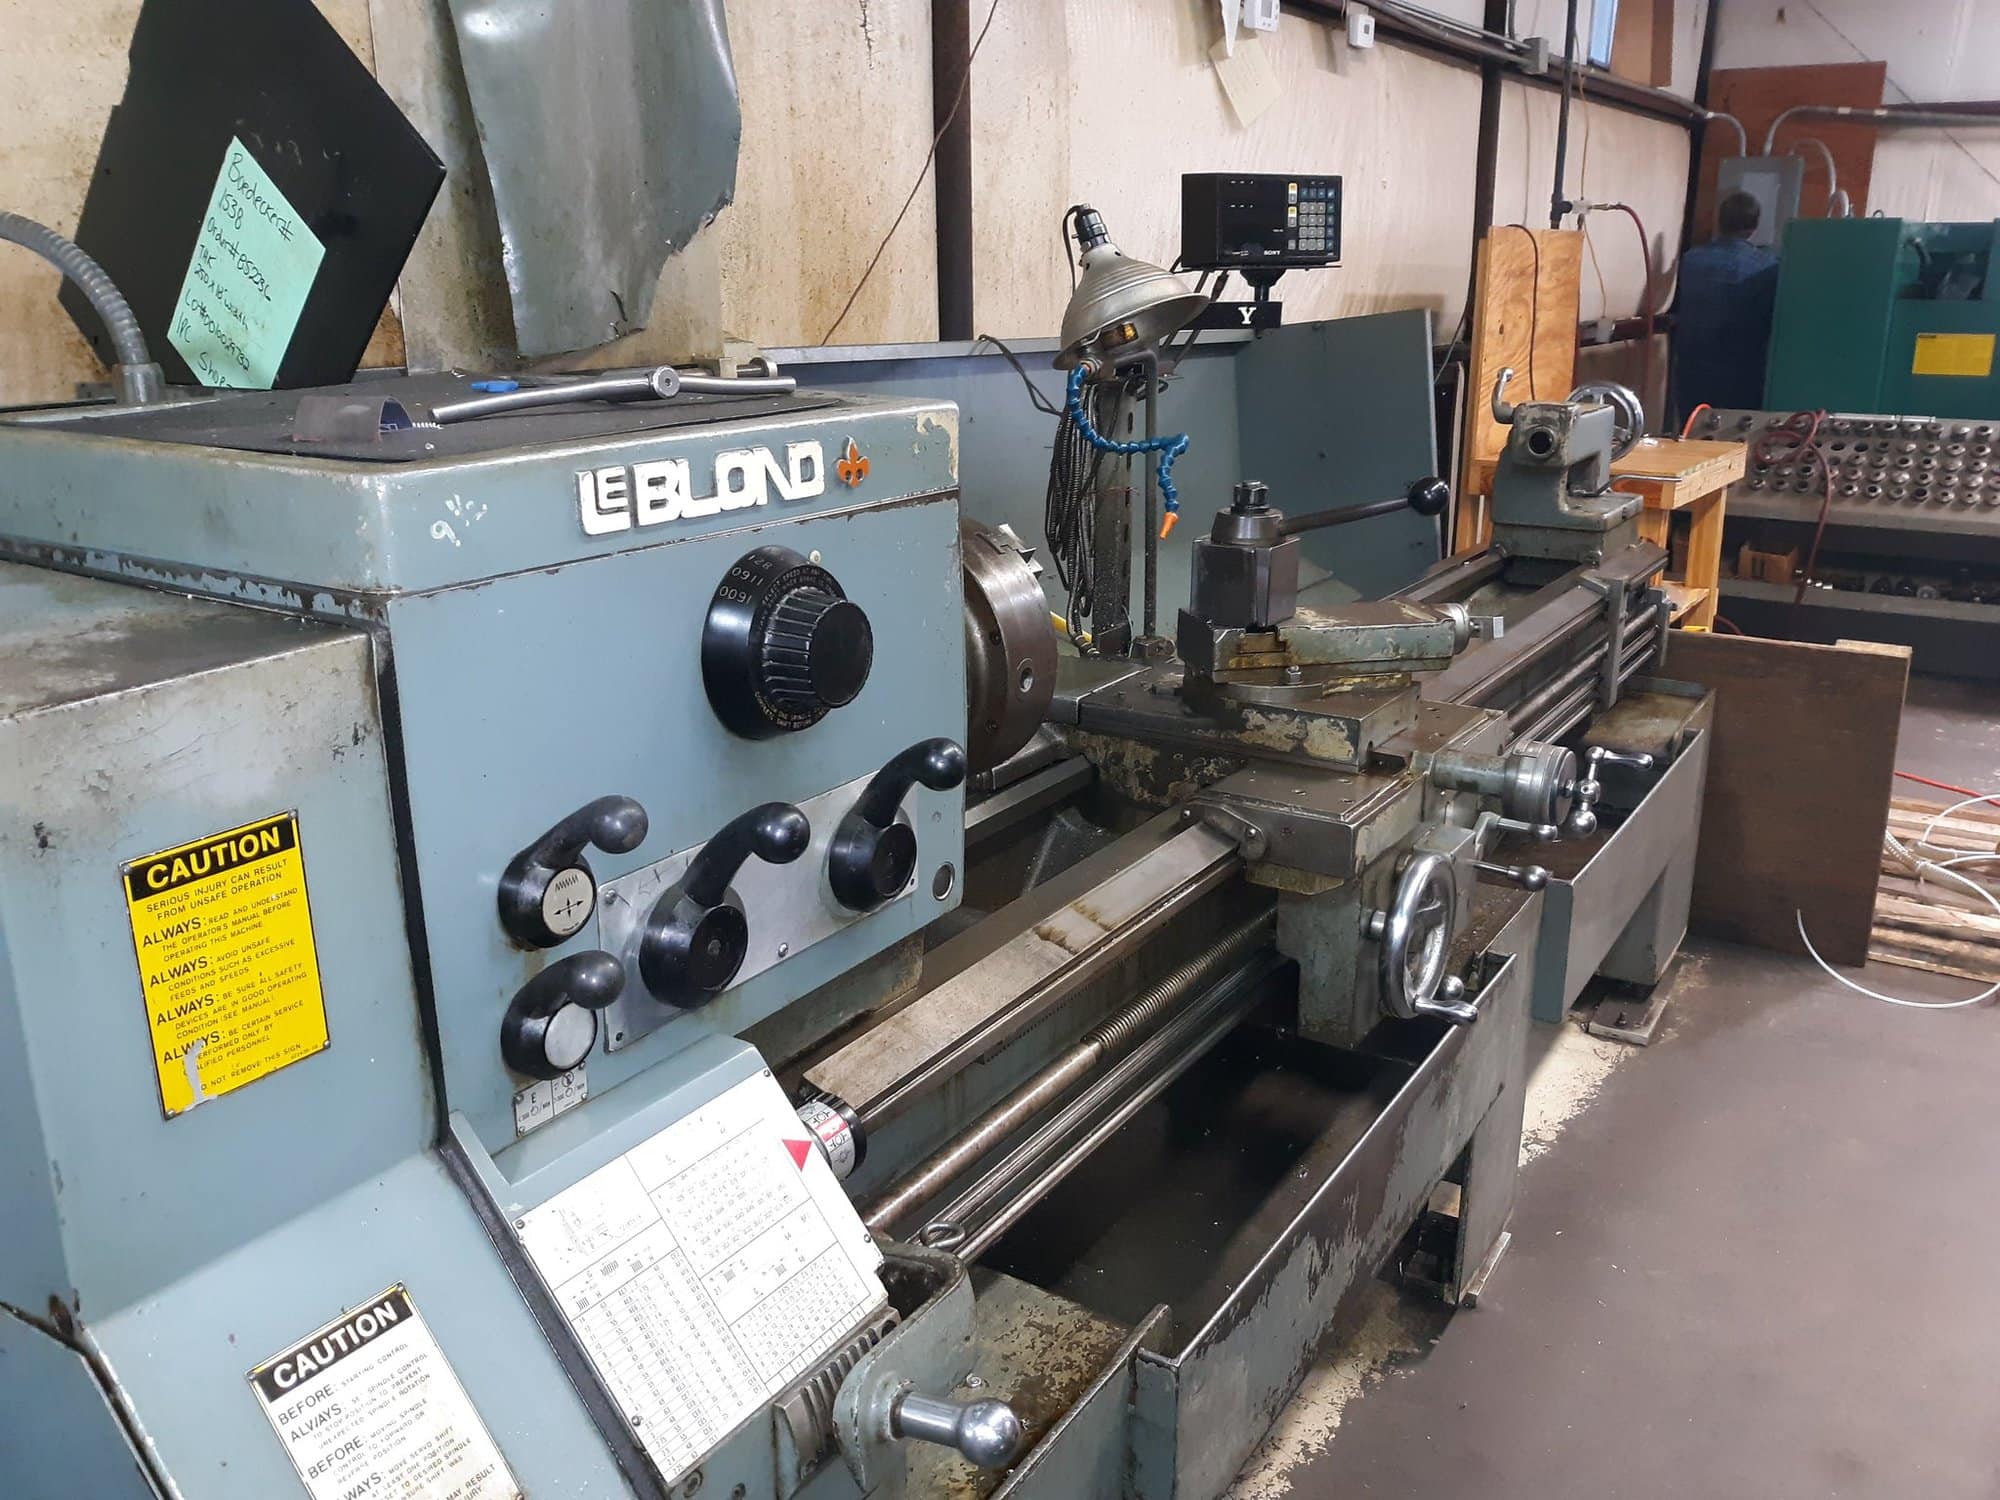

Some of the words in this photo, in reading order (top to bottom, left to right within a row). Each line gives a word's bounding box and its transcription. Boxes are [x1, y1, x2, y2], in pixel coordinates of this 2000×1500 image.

[218, 188, 244, 230] 1538
[1238, 306, 1257, 324] Y
[146, 826, 280, 891] CAUTION
[147, 892, 189, 913] SERIOUS
[195, 879, 226, 896] INJURY
[231, 871, 250, 884] CAN
[254, 859, 287, 876] RESULT
[158, 905, 185, 920] FROM
[190, 890, 227, 909] UNSAFE
[232, 872, 281, 894] OPERATION
[162, 941, 177, 952] THE
[232, 912, 259, 926] MANUAL
[263, 900, 291, 915] BEFORE
[209, 912, 228, 923] READ
[234, 905, 248, 914] AND
[164, 942, 207, 962] OPERATING
[211, 935, 227, 945] THIS
[231, 922, 262, 937] MACHINE
[217, 949, 238, 962] AVOID
[242, 937, 270, 952] UNSAFE
[169, 969, 216, 991] CONDITIONS
[219, 960, 239, 972] SUCH
[241, 954, 251, 963] AS
[256, 939, 294, 958] EXCESSIVE
[222, 990, 232, 999] BE
[237, 982, 255, 994] SURE
[259, 974, 271, 984] ALL
[275, 963, 302, 978] SAFETY
[170, 987, 196, 1002] FEEDS
[200, 979, 215, 990] AND
[220, 967, 249, 982] SPEEDS
[176, 1012, 208, 1030] DEVICES
[213, 1004, 226, 1014] ARE
[230, 999, 239, 1007] IN
[242, 989, 264, 1002] GOOD
[268, 972, 306, 992] OPERATING
[163, 1028, 225, 1064] ALWYS:
[228, 1027, 238, 1036] BE
[242, 1014, 270, 1030] CERTAIN
[275, 1000, 303, 1016] SERVICE
[177, 1018, 218, 1039] CONDITION
[227, 1035, 270, 1057] PERSONNEL
[242, 1029, 260, 1041] ONLY
[264, 1022, 273, 1031] BY
[211, 1075, 226, 1086] NOT
[231, 1060, 260, 1077] REMOVE
[265, 1051, 280, 1062] THIS
[284, 1042, 300, 1054] SIGN
[271, 1301, 399, 1390] CAUTION
[377, 1343, 408, 1363] CONTROL
[398, 1353, 428, 1374] CONTROL
[392, 1368, 423, 1388] PREVENT
[399, 1374, 431, 1395] ROTATION
[388, 1459, 408, 1473] MOVE
[435, 1426, 455, 1441] SHIFT
[413, 1460, 443, 1480] DESIRED
[444, 1439, 472, 1458] SPINDLE
[423, 1438, 456, 1461] POSITION
[465, 1465, 496, 1488] RESULT
